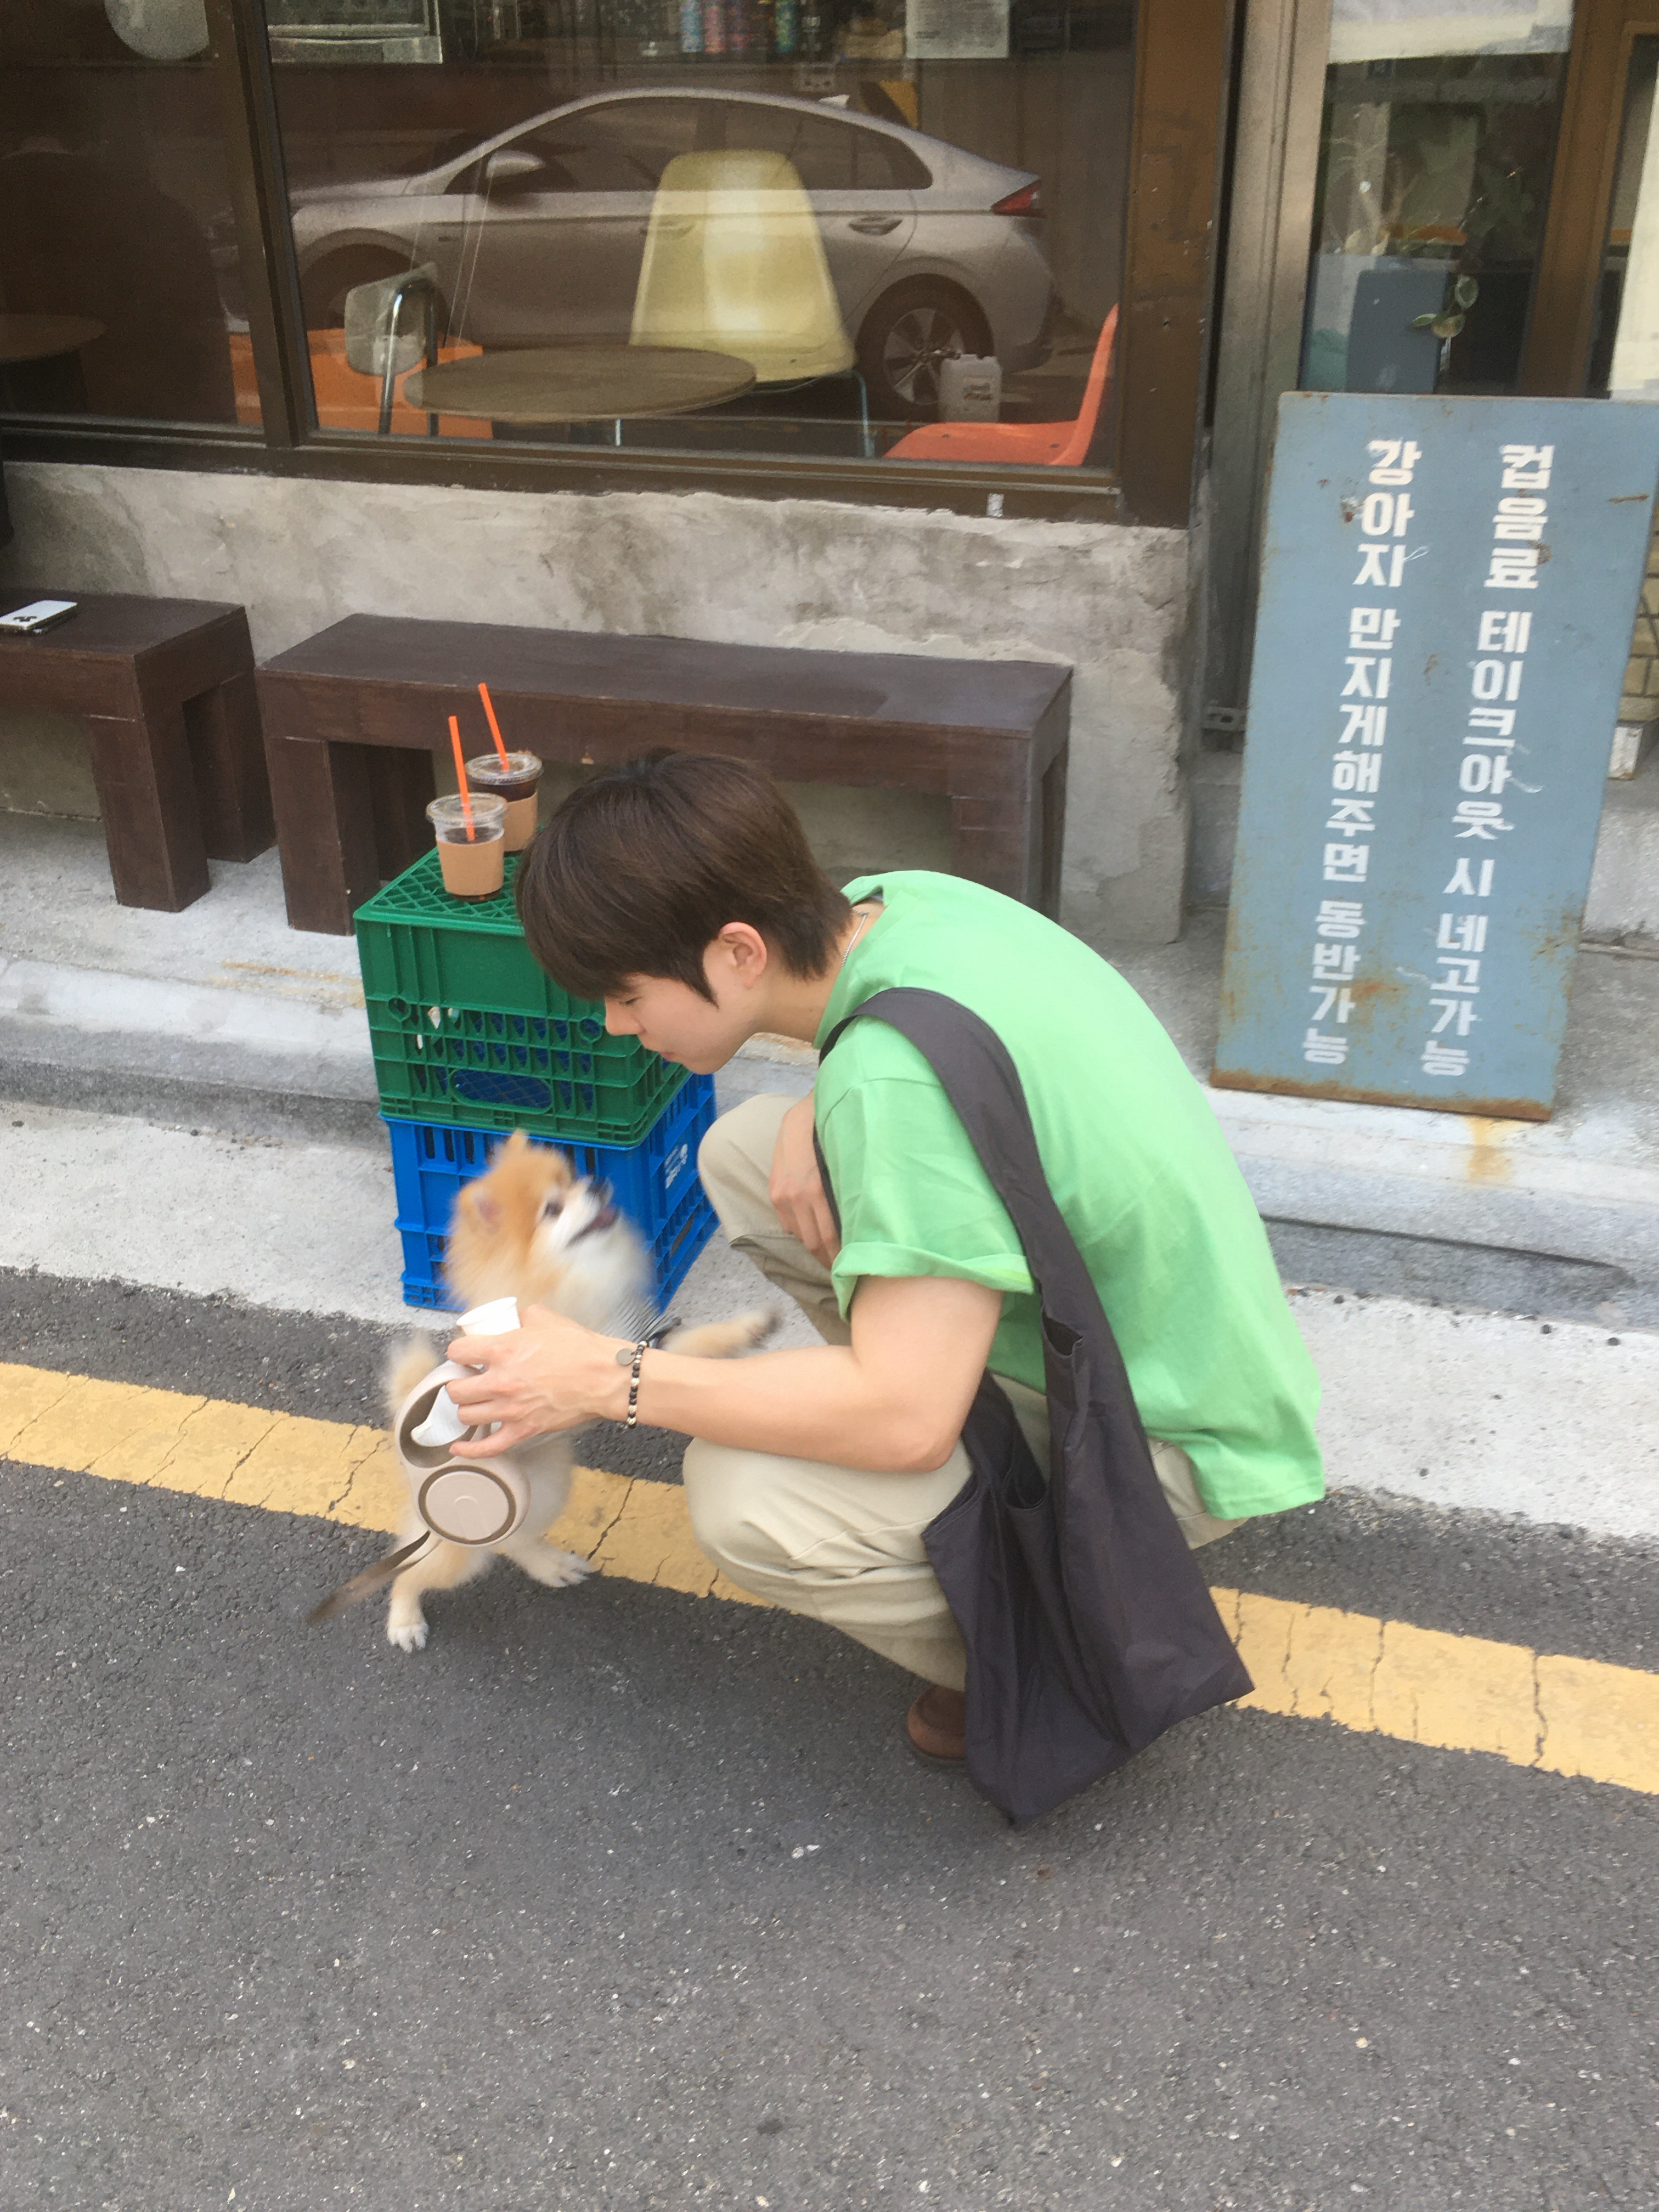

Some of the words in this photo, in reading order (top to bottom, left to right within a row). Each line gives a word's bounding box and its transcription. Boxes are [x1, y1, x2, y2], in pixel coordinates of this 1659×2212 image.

[1352, 438, 1422, 587] 강아지
[1483, 444, 1555, 589] 컵음료
[1324, 607, 1401, 882] 만지게해주면
[1452, 611, 1532, 840] 테이크아웃
[1443, 857, 1495, 897] 시
[1304, 900, 1365, 1064] 동반가능
[1421, 913, 1488, 1076] 네고가능
